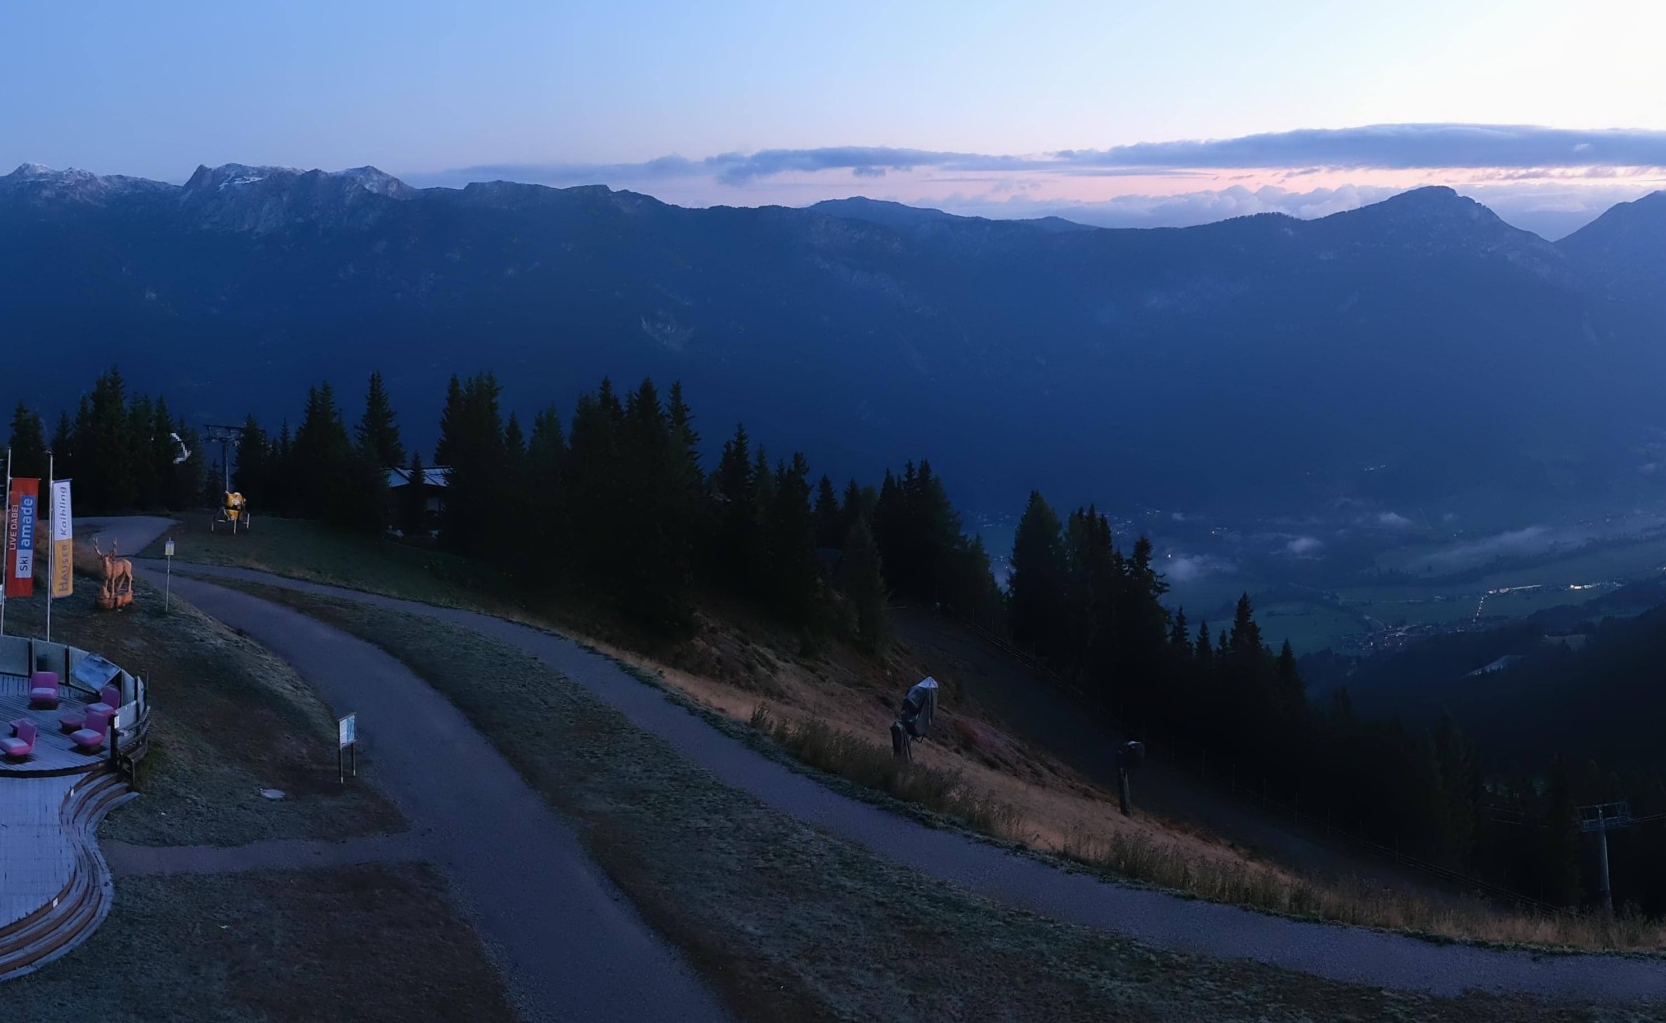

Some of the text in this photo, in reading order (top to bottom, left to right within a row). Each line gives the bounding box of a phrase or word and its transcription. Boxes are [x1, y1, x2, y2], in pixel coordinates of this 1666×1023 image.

[9, 504, 19, 551] LIVE DABEI
[59, 486, 67, 536] Kaibling
[19, 556, 29, 572] Ski
